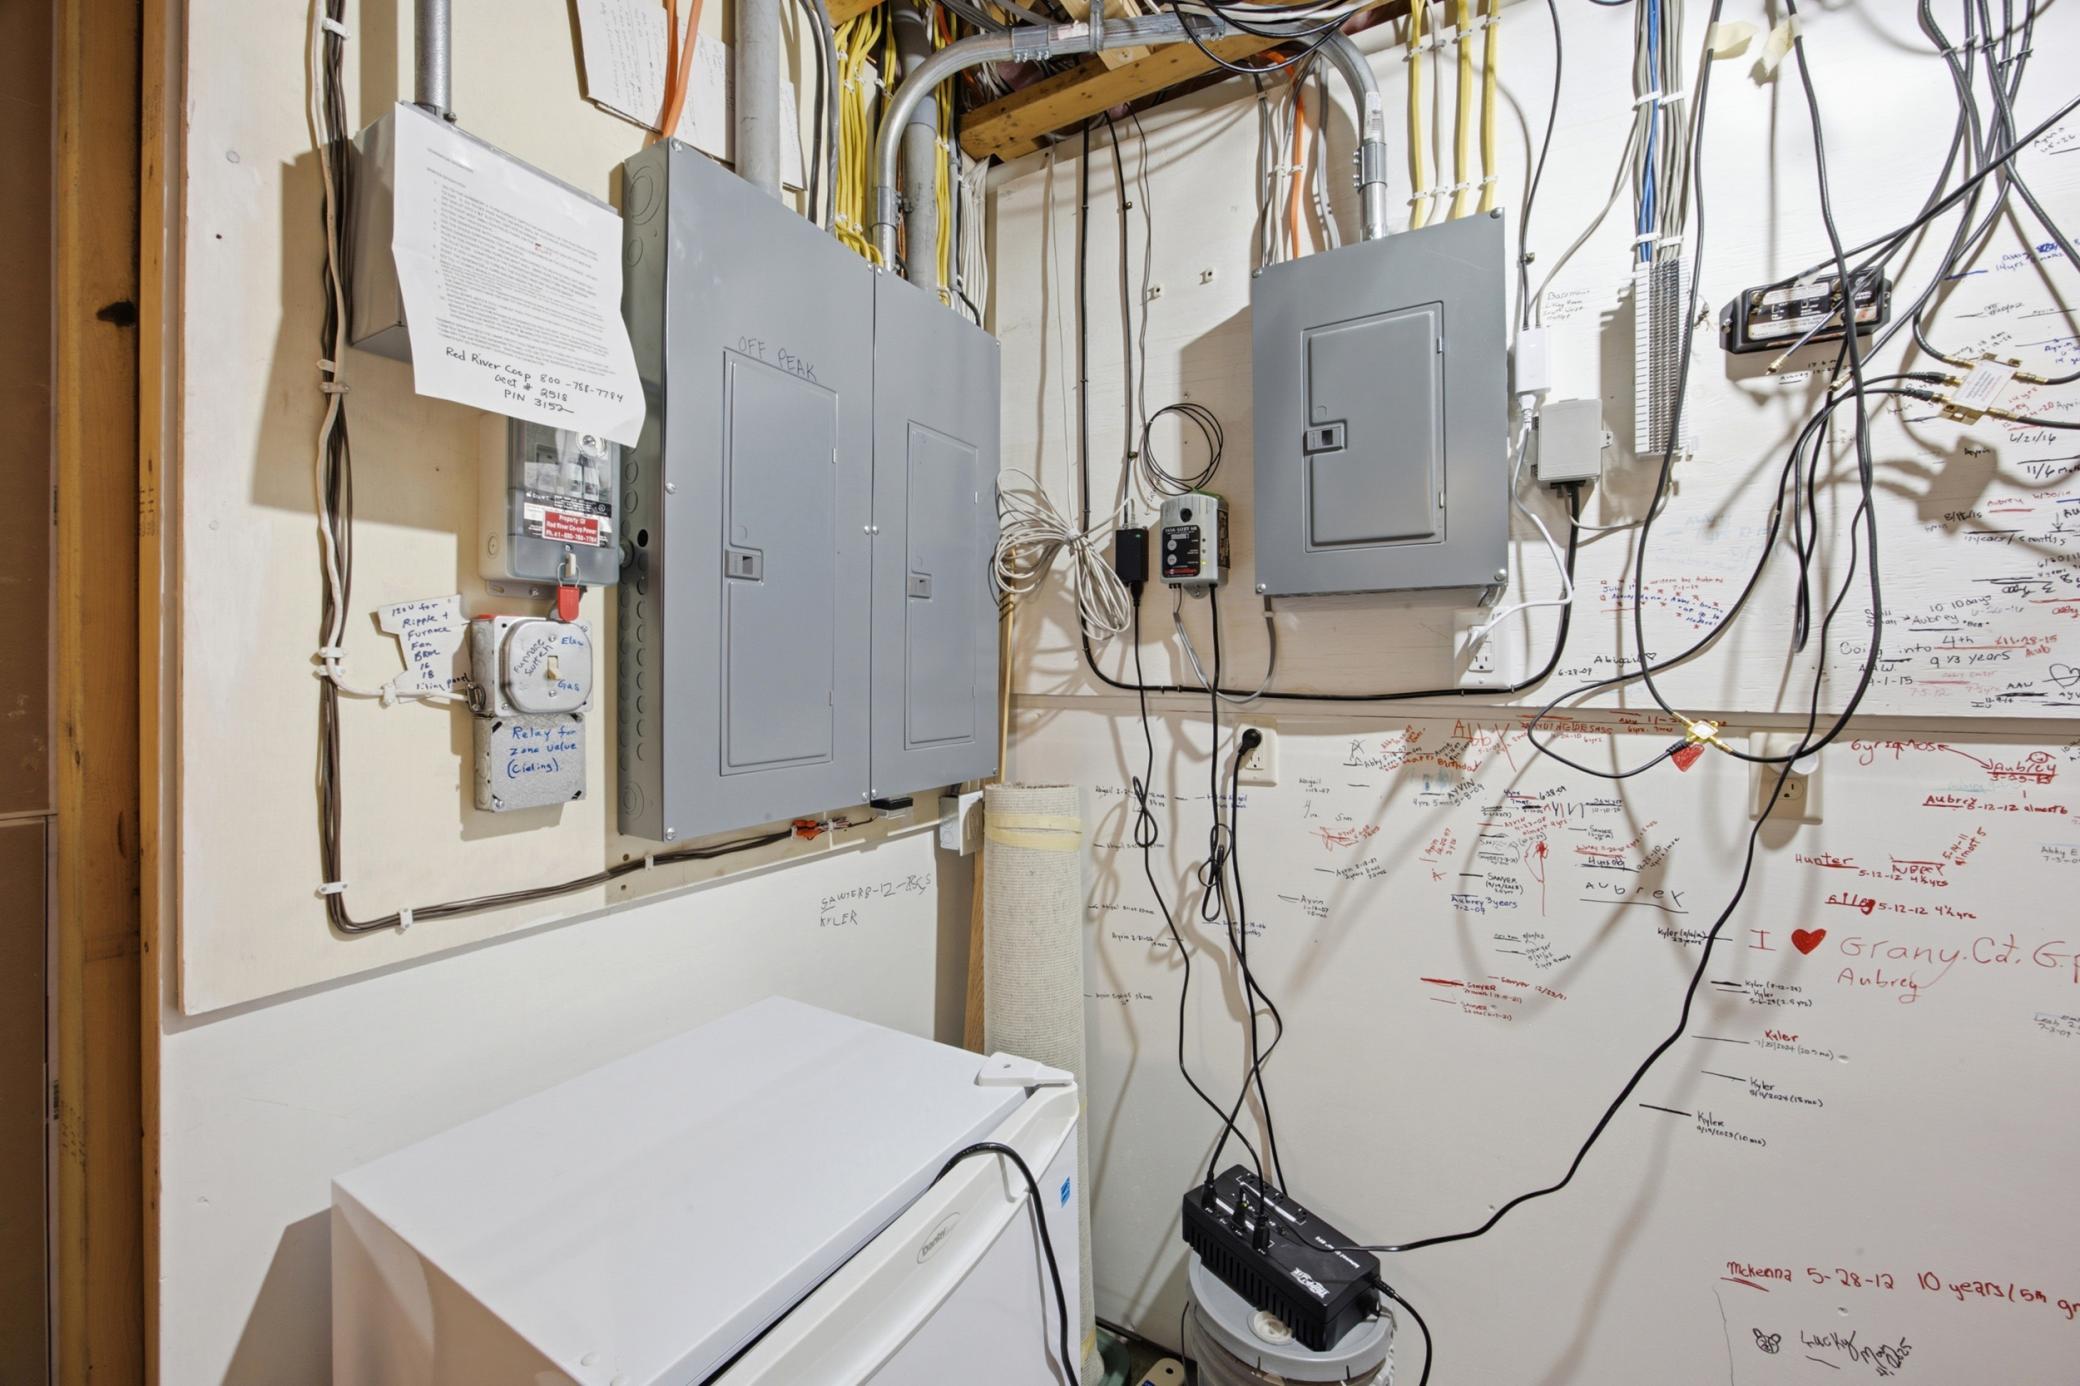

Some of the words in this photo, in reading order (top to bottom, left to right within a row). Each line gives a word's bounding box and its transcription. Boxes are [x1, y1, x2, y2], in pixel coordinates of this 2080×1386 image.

[446, 346, 466, 361] Red
[471, 353, 501, 370] River
[505, 364, 531, 382] Coop
[738, 336, 766, 359] OFF
[777, 347, 817, 382] PEAK
[504, 389, 525, 401] PIN
[419, 603, 439, 611] for
[402, 615, 438, 629] Ripple
[407, 627, 451, 641] Furnace
[1968, 651, 2011, 667] years
[557, 679, 580, 691] Gas
[512, 725, 551, 741] Relay
[1447, 778, 1475, 799] AYVIN
[1795, 852, 1853, 866] Hunter
[1451, 895, 1484, 907] Aubrey
[1492, 900, 1518, 909] years
[820, 909, 858, 927] KYLER
[1749, 929, 1777, 951] I
[1765, 1029, 1798, 1042] Kyler
[1750, 1077, 1775, 1091] Kyler
[1807, 1267, 1895, 1290] 5-28-12
[1917, 1271, 1941, 1292] 10
